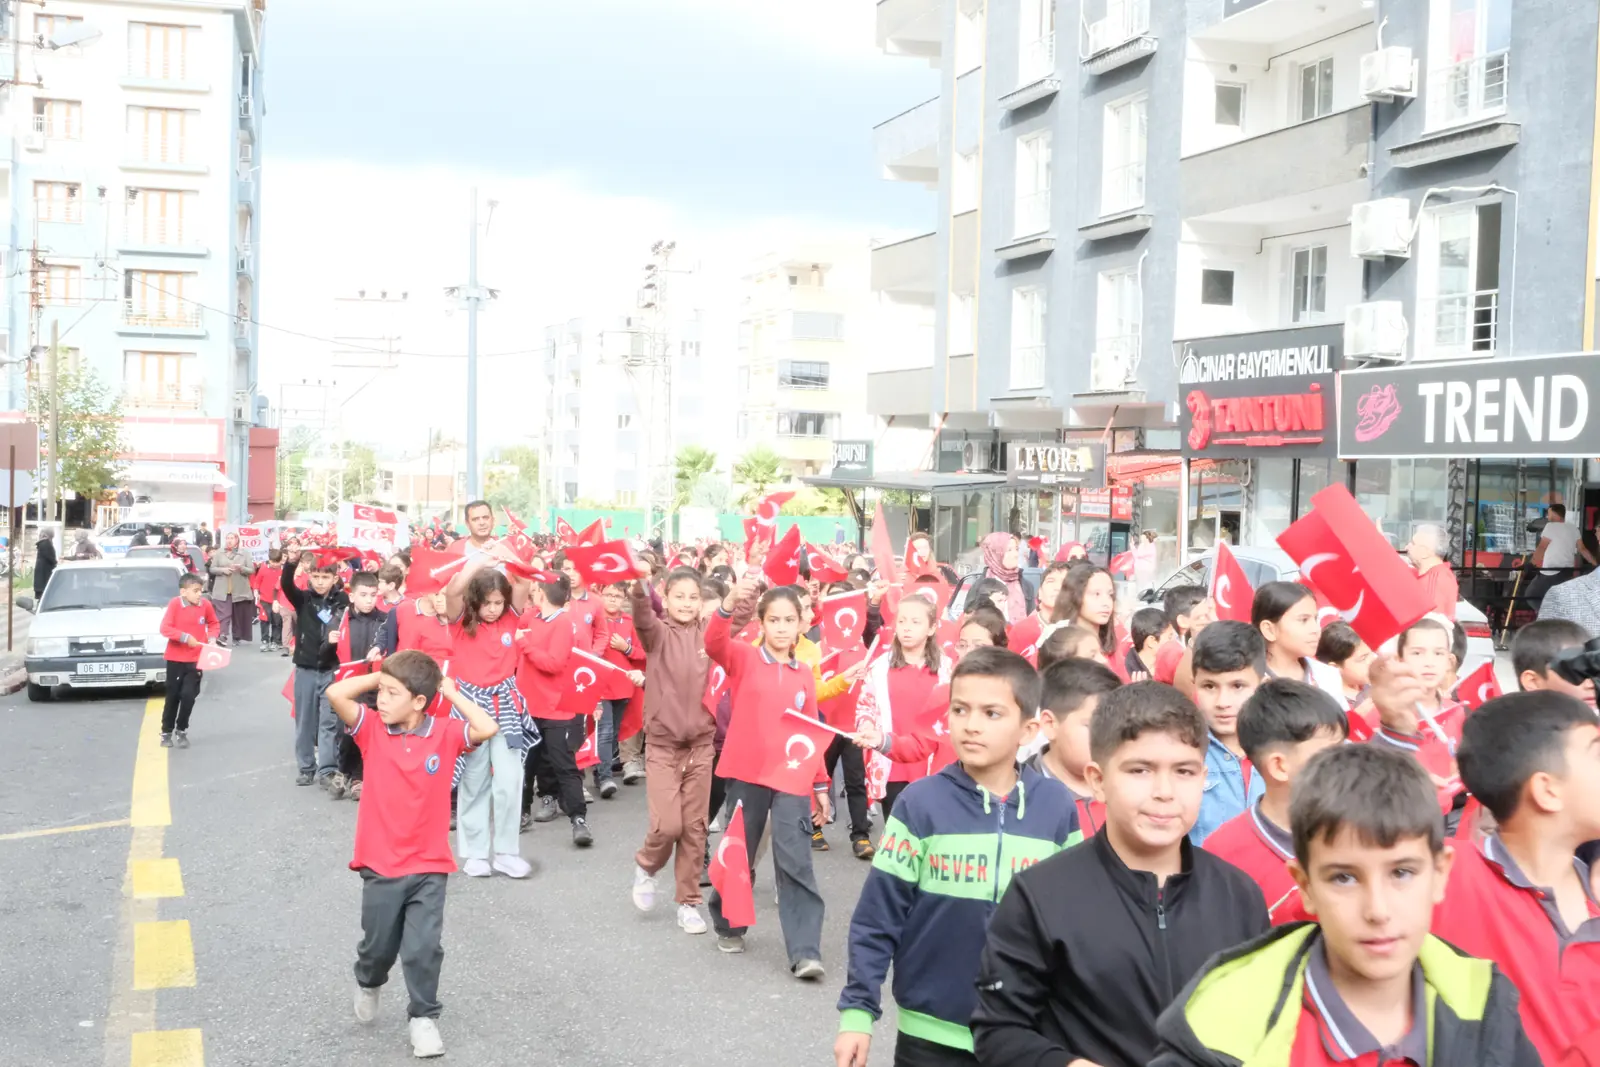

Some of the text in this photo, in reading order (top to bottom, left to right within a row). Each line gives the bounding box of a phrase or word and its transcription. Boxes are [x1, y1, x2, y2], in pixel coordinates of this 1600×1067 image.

[1418, 374, 1588, 444] TREND
[1014, 446, 1086, 472] LEVORA
[83, 662, 135, 673] 06 EMJ 786
[929, 853, 988, 883] NEVER
